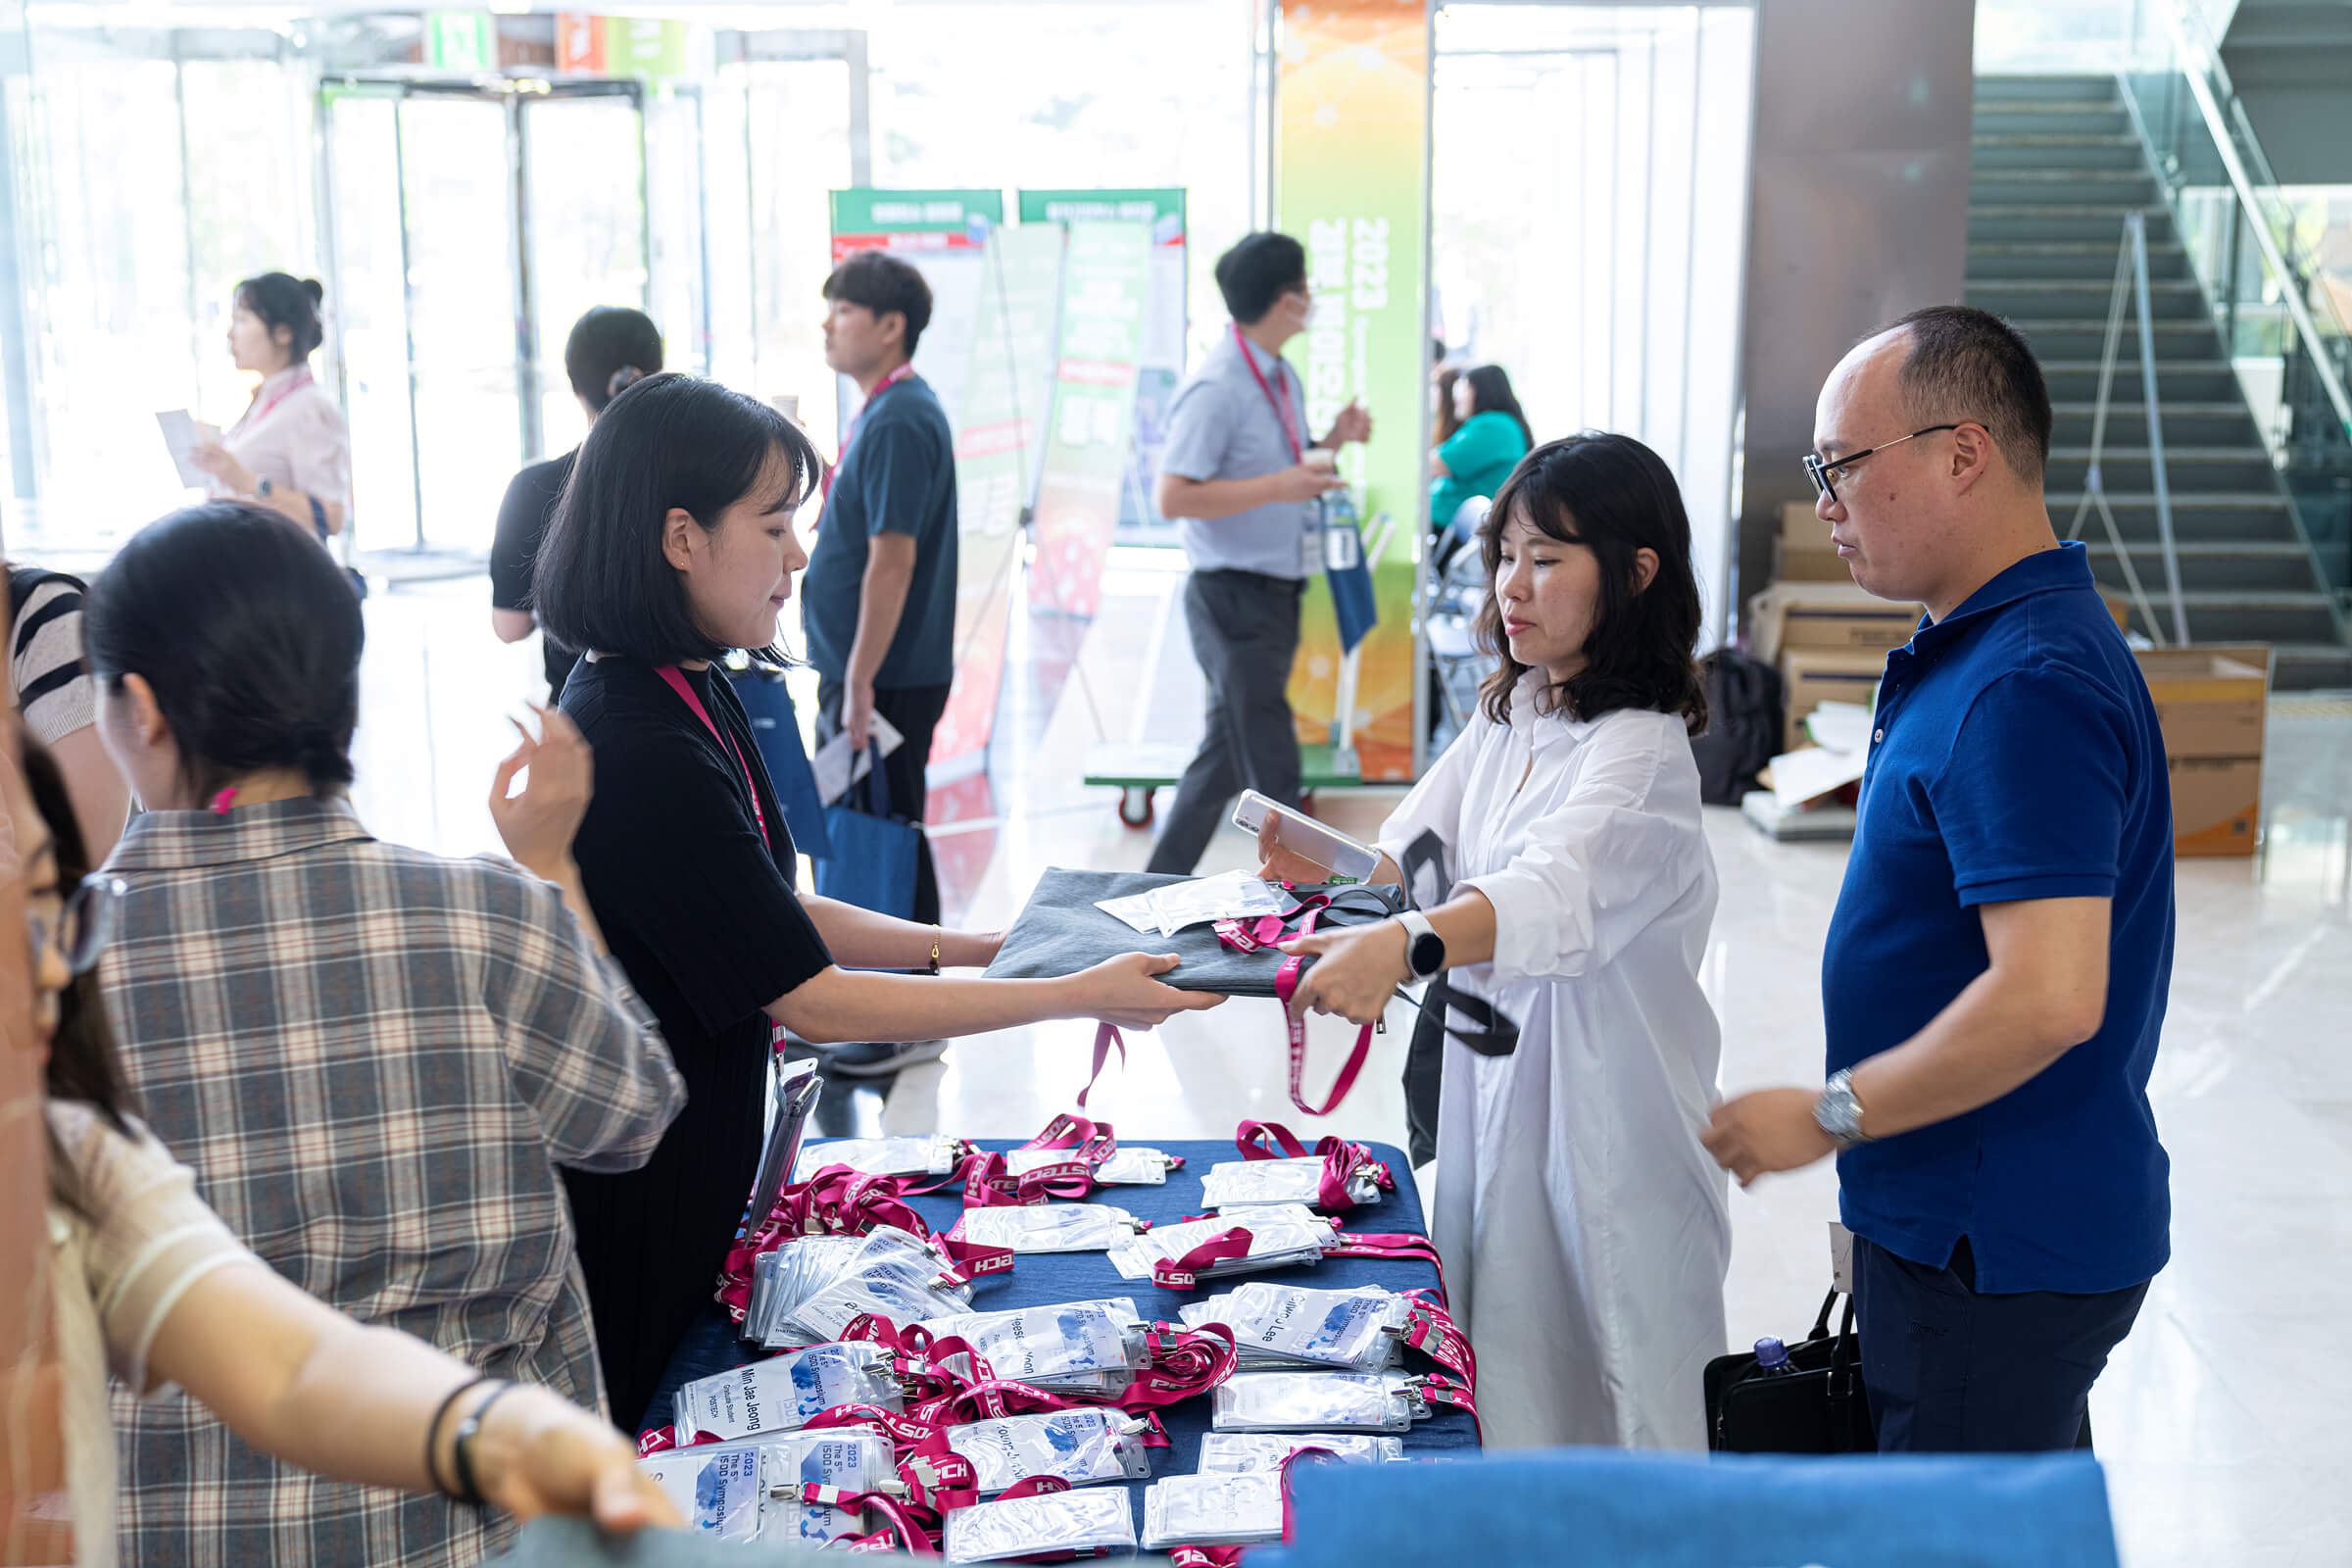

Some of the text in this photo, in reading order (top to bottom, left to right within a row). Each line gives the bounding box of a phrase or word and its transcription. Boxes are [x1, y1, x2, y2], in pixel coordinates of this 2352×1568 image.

[1262, 1326, 1285, 1343] Lee
[811, 1366, 827, 1405] Symposium
[741, 1368, 761, 1431] Min Jae Jeong
[730, 1453, 740, 1471] The
[743, 1452, 754, 1477] 2023
[834, 1445, 843, 1460] The
[847, 1444, 857, 1468] 2023
[716, 1478, 728, 1536] Symposium
